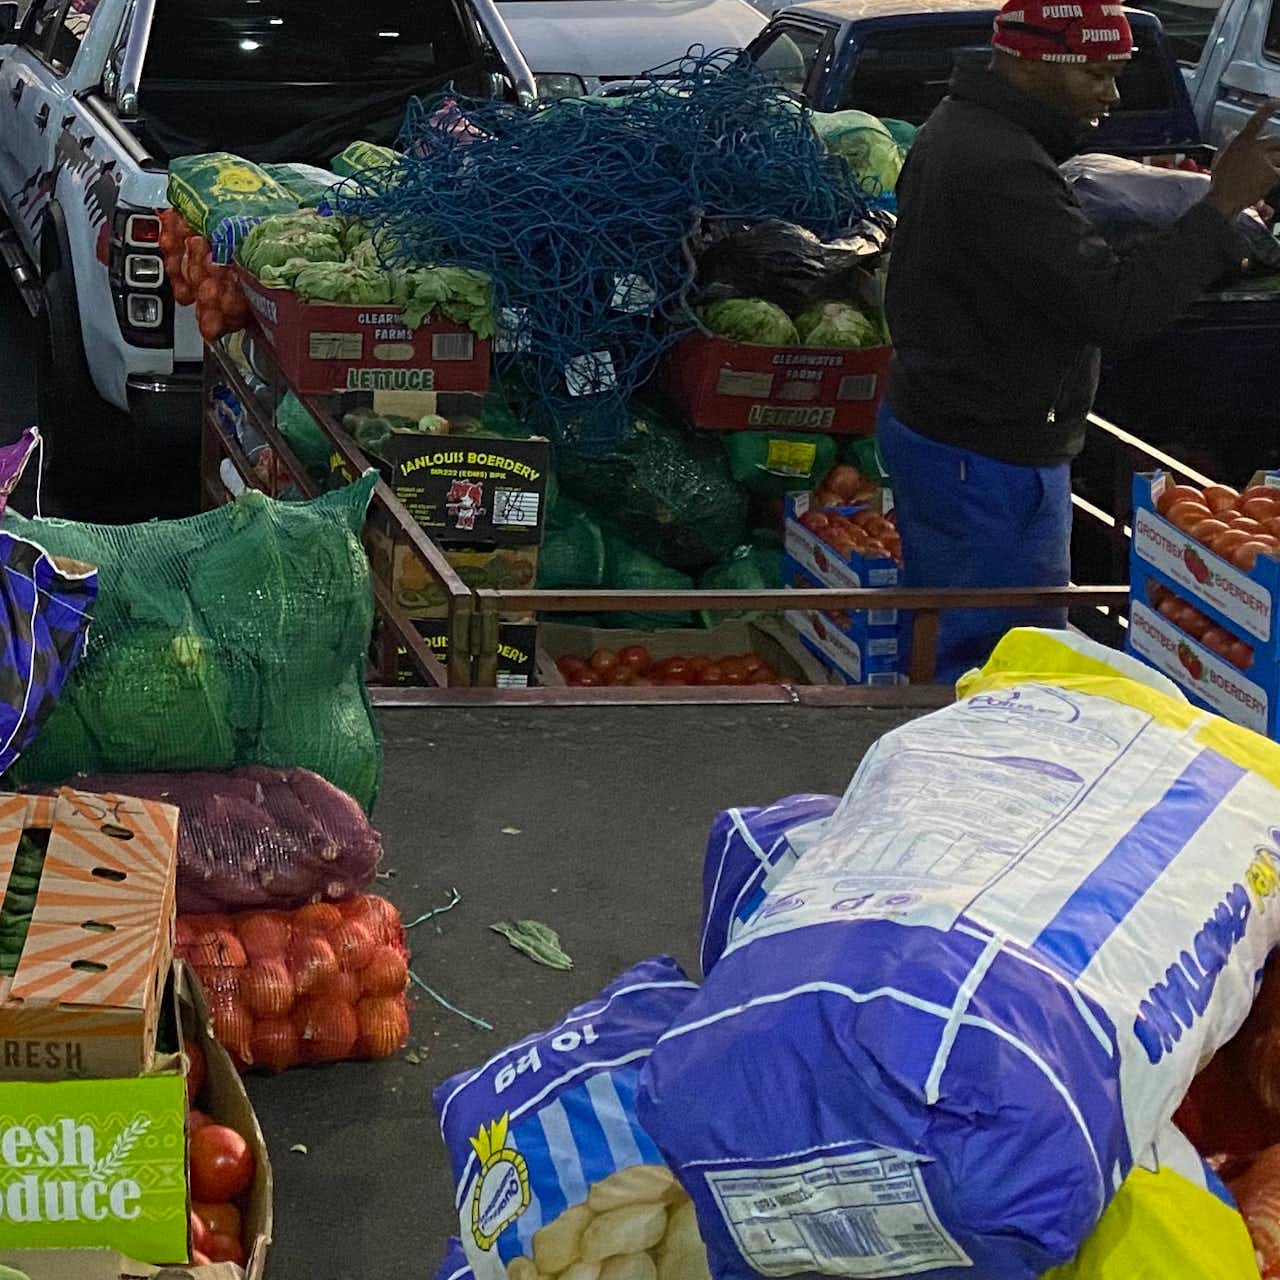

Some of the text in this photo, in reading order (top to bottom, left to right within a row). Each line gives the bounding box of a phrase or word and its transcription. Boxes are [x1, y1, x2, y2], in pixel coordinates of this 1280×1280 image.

[1042, 4, 1083, 19] PUMA
[1081, 28, 1121, 43] PUMA
[375, 328, 414, 341] FARMS
[772, 354, 843, 367] CLEARWATER
[347, 368, 435, 391] LETTUCE
[785, 370, 824, 381] FARMS
[748, 405, 836, 428] LETTUCE
[400, 452, 541, 481] JANLOUIS BOERDERY
[1214, 577, 1270, 617] BOERDERY
[1209, 669, 1266, 716] BOERDERY
[494, 1023, 600, 1095] 10 kg
